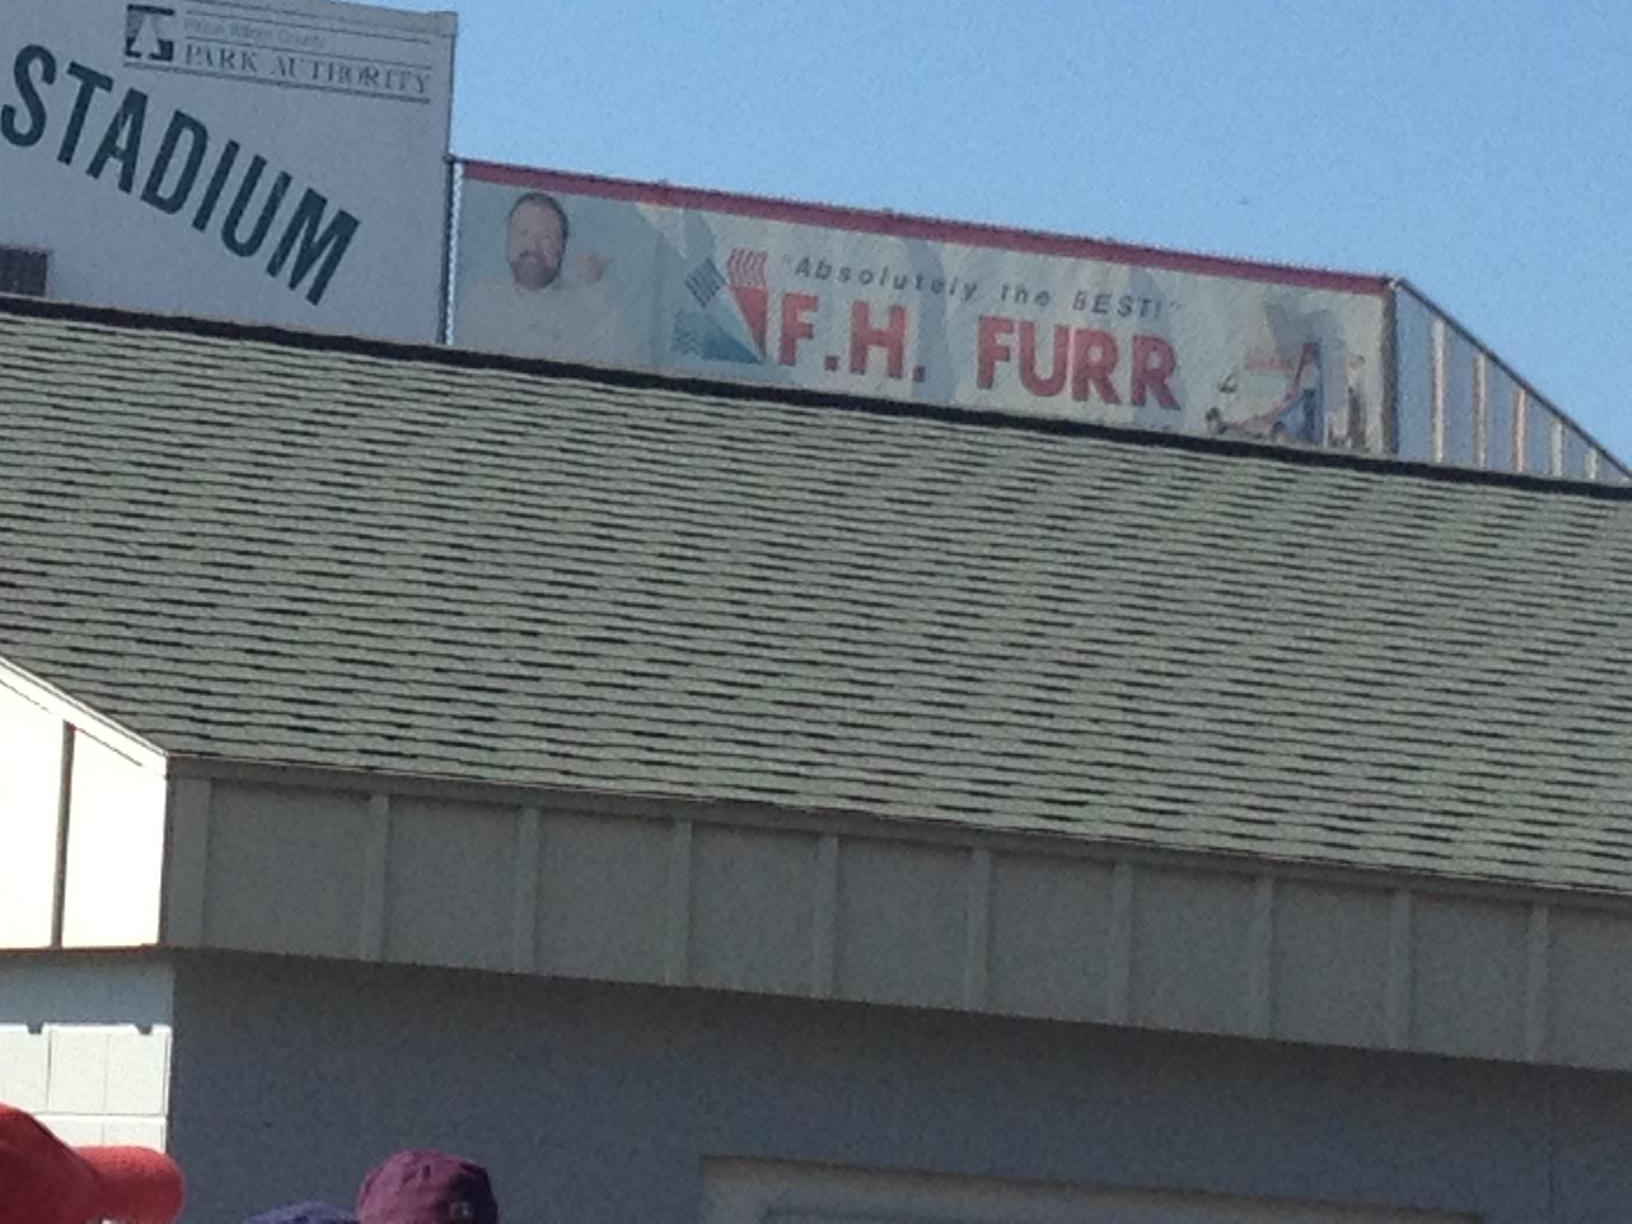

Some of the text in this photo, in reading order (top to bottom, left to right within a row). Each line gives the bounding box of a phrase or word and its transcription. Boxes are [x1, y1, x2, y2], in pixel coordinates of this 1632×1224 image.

[185, 43, 431, 95] PARK AUTHORITY
[0, 44, 361, 306] STADIUM
[1001, 283, 1051, 307] the
[778, 291, 1180, 411] F.H. FURR
